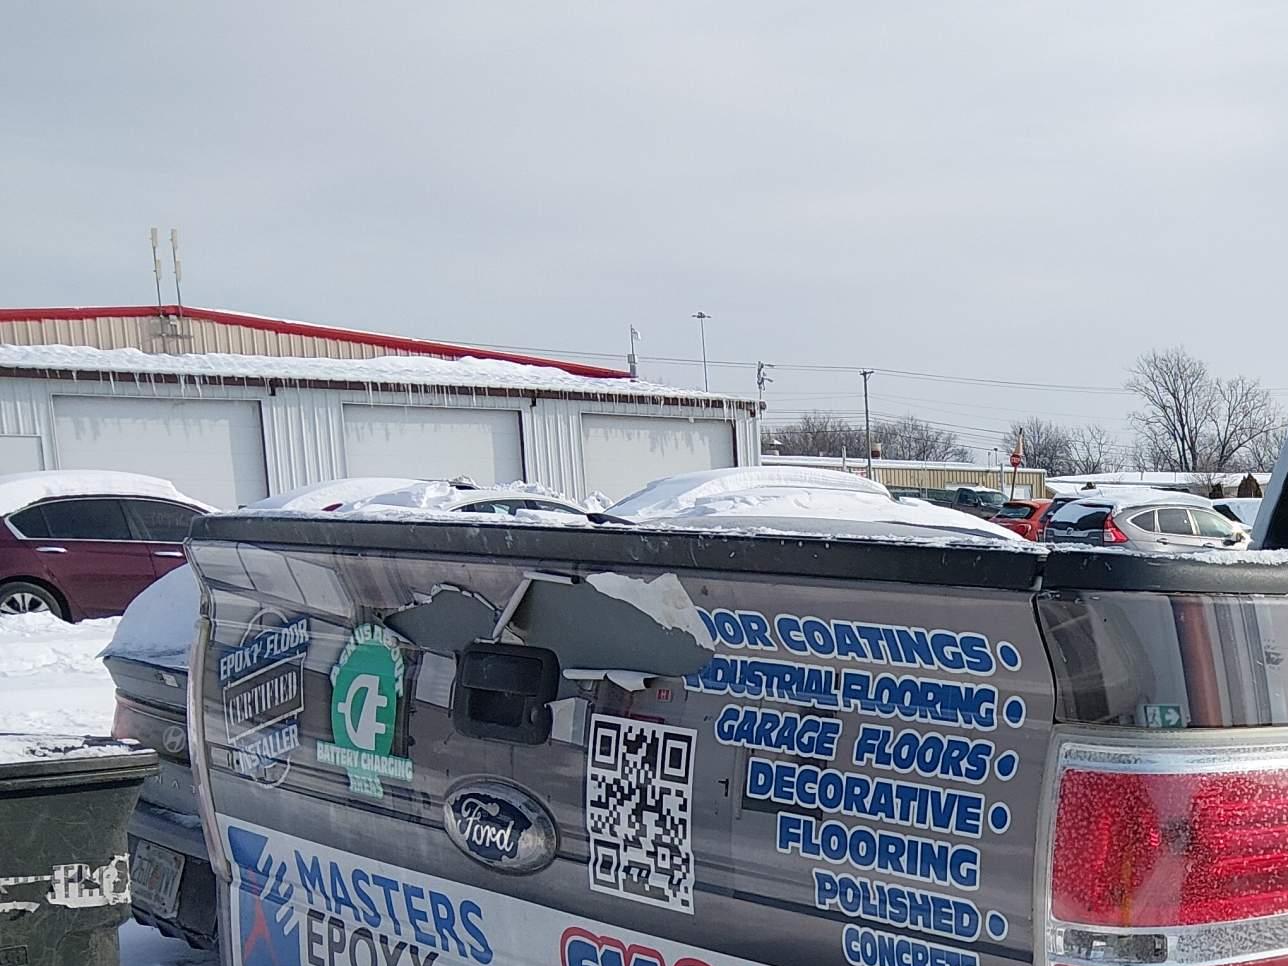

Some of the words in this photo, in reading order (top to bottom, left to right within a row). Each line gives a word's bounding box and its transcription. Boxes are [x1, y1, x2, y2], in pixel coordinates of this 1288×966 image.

[219, 641, 264, 681] EPOXY
[264, 618, 310, 660] FLOOR
[354, 623, 371, 645] US
[371, 623, 405, 698] ABOUT
[774, 614, 996, 675] COATINGS
[228, 671, 299, 727] CERTIFIED
[682, 654, 840, 711] DUSTRIAL
[841, 669, 999, 731] FLOORING
[239, 724, 300, 773] INSTALLER
[316, 740, 360, 769] BATTERY
[359, 751, 414, 783] CHARGING
[715, 702, 841, 760] GARAGE
[854, 726, 995, 785] FLOORS
[458, 796, 517, 856] Ford
[747, 757, 986, 839] DECORATIVE
[777, 812, 981, 890] FLOORING
[293, 849, 494, 965] MASTERS
[812, 868, 981, 944] POLISHED
